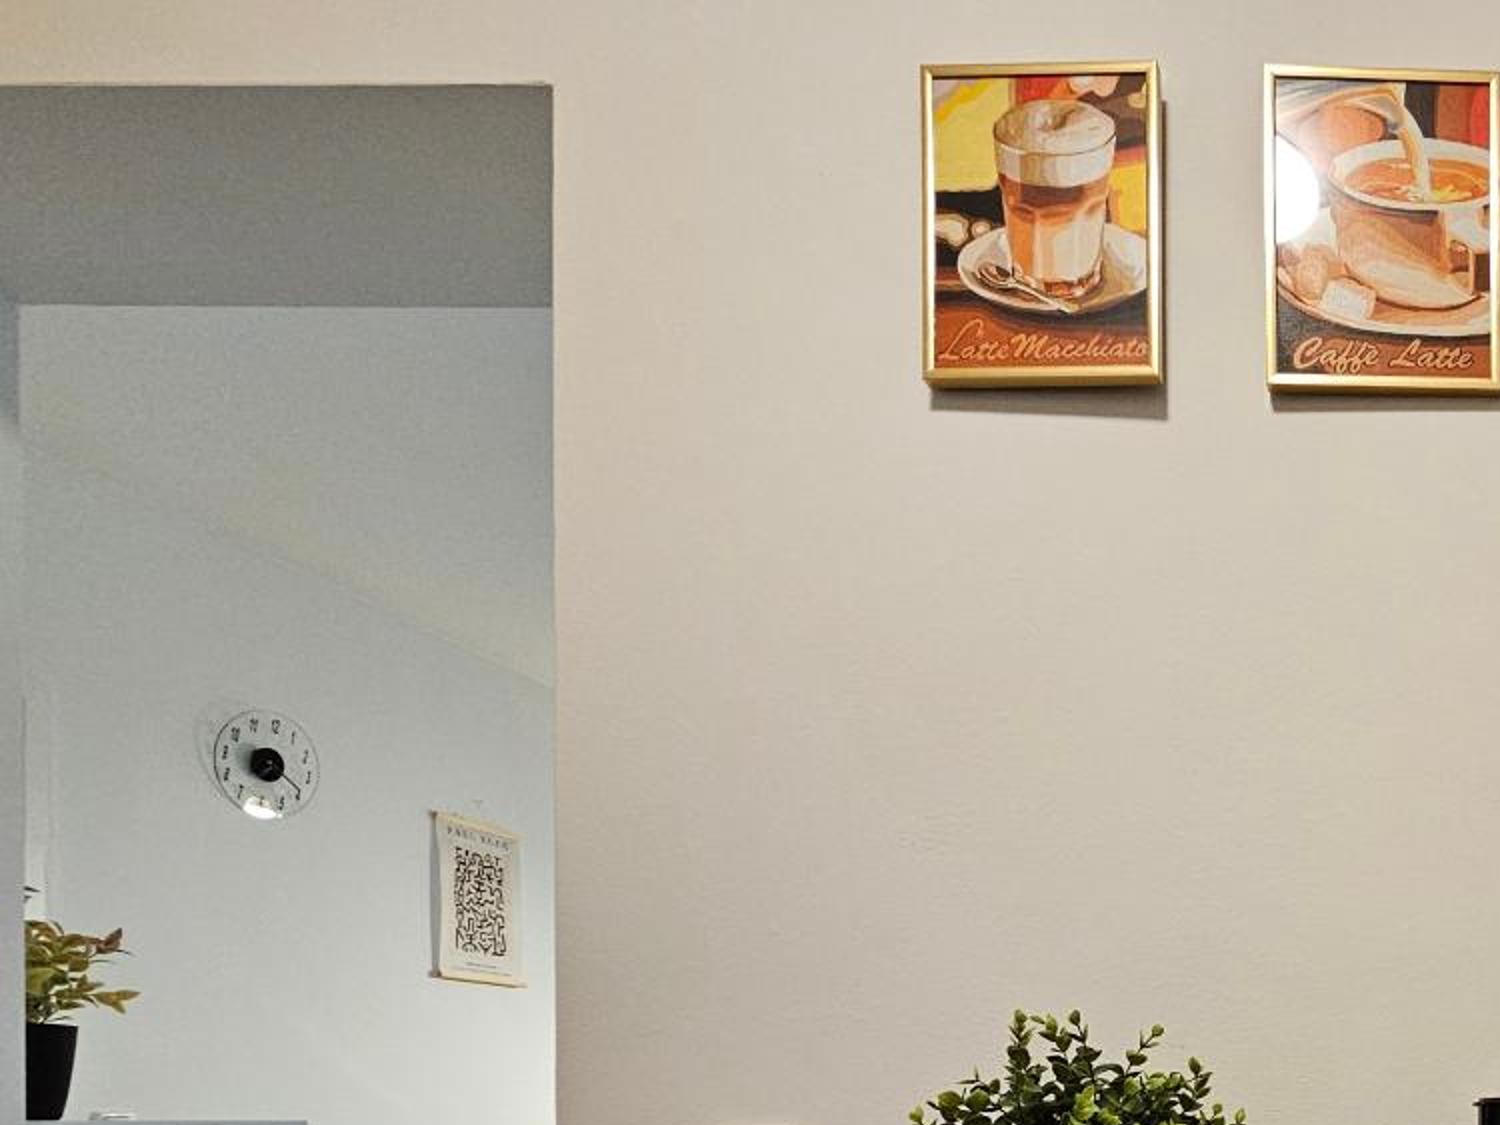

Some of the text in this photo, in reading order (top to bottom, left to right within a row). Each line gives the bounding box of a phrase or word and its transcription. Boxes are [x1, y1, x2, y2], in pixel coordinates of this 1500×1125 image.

[938, 318, 1148, 361] Latte Macchiato
[1390, 338, 1474, 368] Latte
